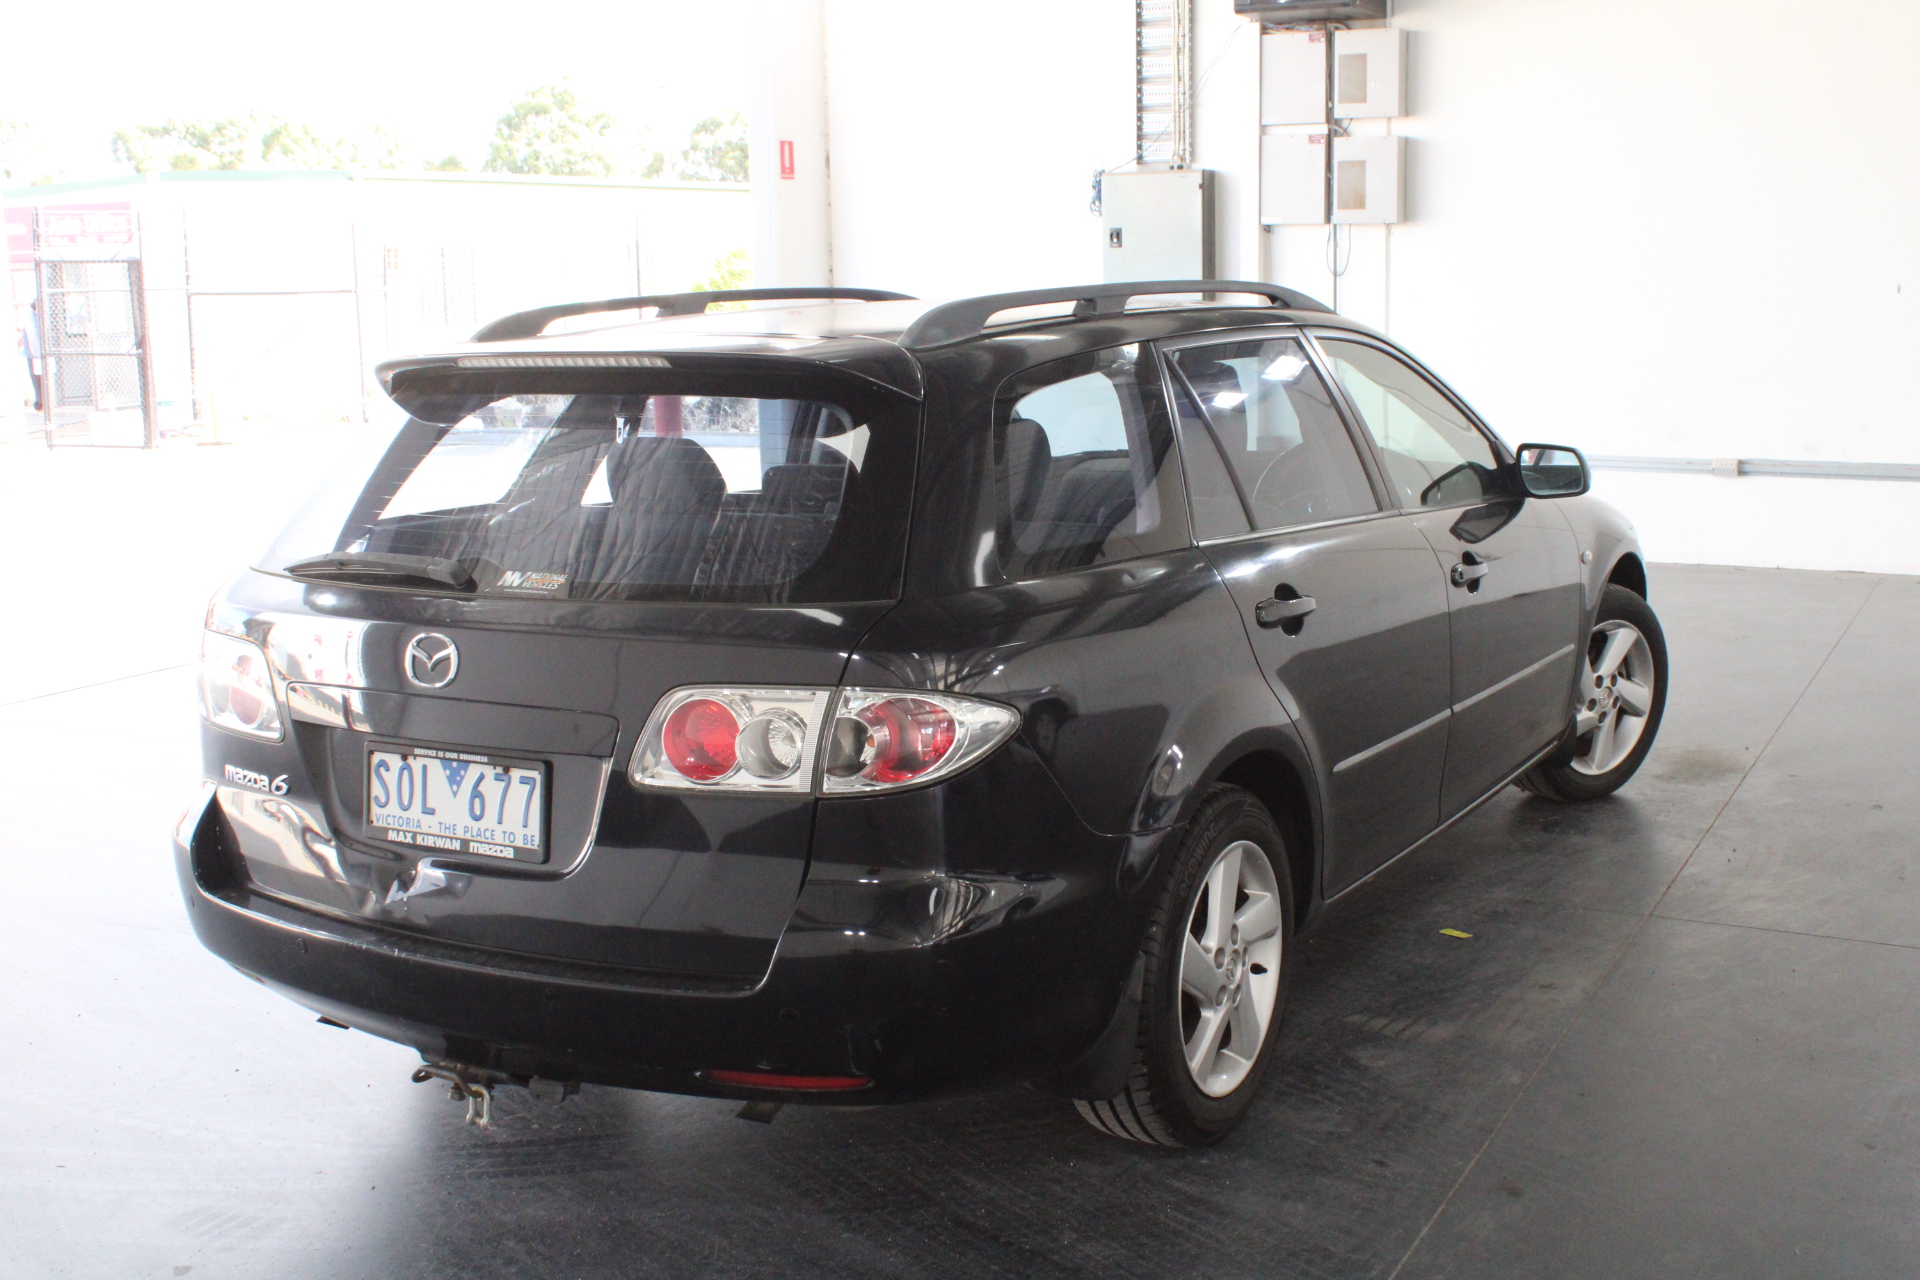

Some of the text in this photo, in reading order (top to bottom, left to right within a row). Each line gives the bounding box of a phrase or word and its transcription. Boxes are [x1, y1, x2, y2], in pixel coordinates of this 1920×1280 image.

[522, 580, 561, 589] VEHICLES
[529, 572, 568, 582] NATIONAL
[414, 748, 437, 757] SERVICE
[460, 753, 488, 763] BUSINESS
[373, 758, 537, 829] SOL 677
[375, 812, 422, 831] VICTORIA
[438, 821, 458, 836] THE
[464, 825, 496, 842] PLACE
[502, 830, 516, 844] TO
[523, 834, 536, 847] BE
[387, 829, 514, 859] MAX KIRWAN mazda
